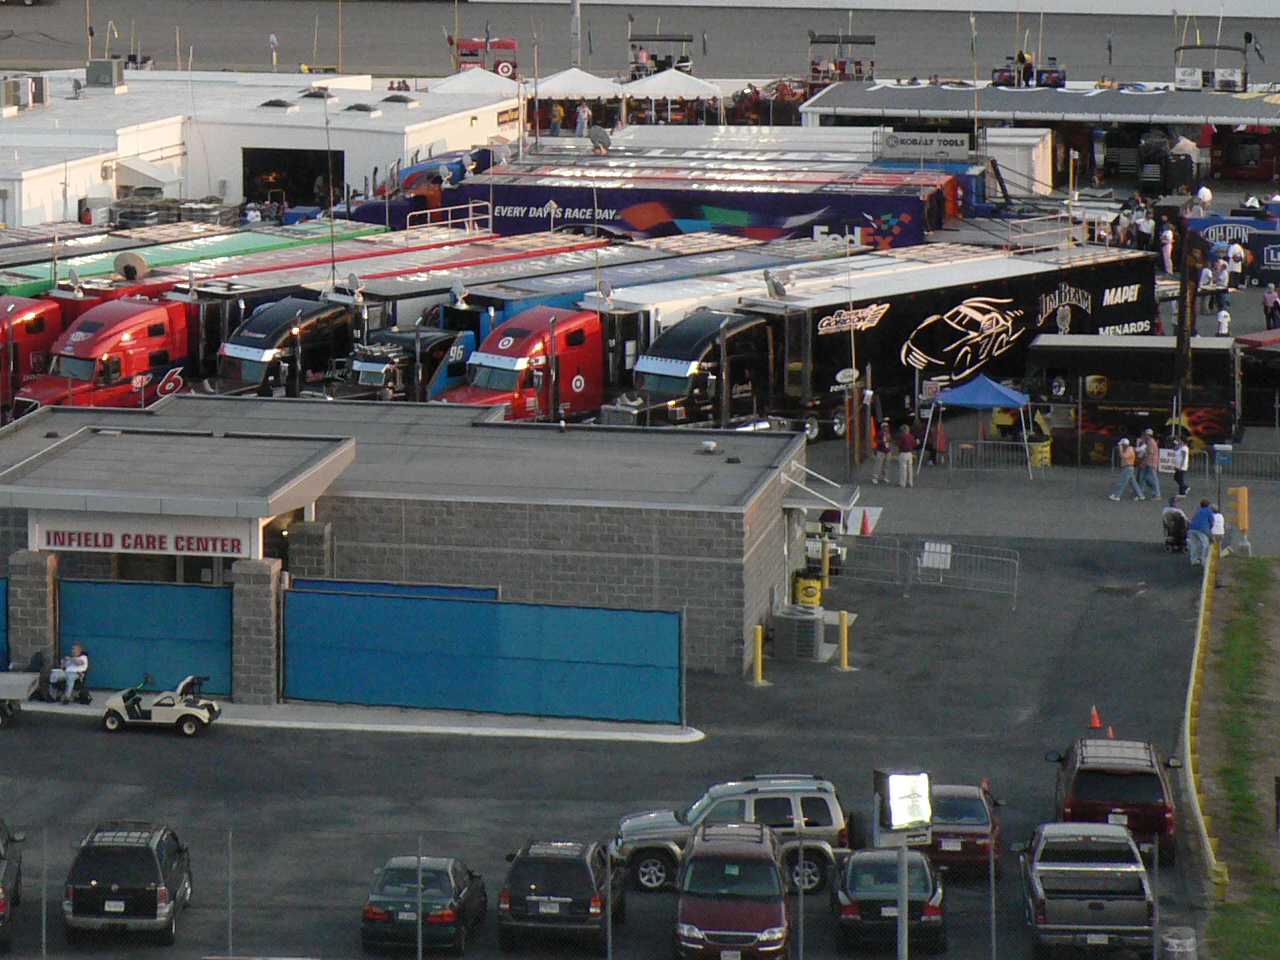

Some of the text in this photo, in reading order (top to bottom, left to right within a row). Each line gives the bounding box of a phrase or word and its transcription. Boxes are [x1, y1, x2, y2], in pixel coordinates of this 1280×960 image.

[900, 138, 965, 147] KOBALT TOOLS
[494, 206, 527, 217] EVERY
[528, 207, 552, 218] DAY
[564, 208, 594, 220] RACE
[595, 209, 616, 220] DAY
[813, 225, 895, 249] FedEx
[1059, 282, 1092, 315] BEAM
[1102, 283, 1141, 307] MAPEI
[1098, 320, 1151, 337] MENARDS
[448, 345, 464, 361] 96
[156, 366, 184, 398] 6
[46, 530, 242, 553] INFIELD CARE CENTER
